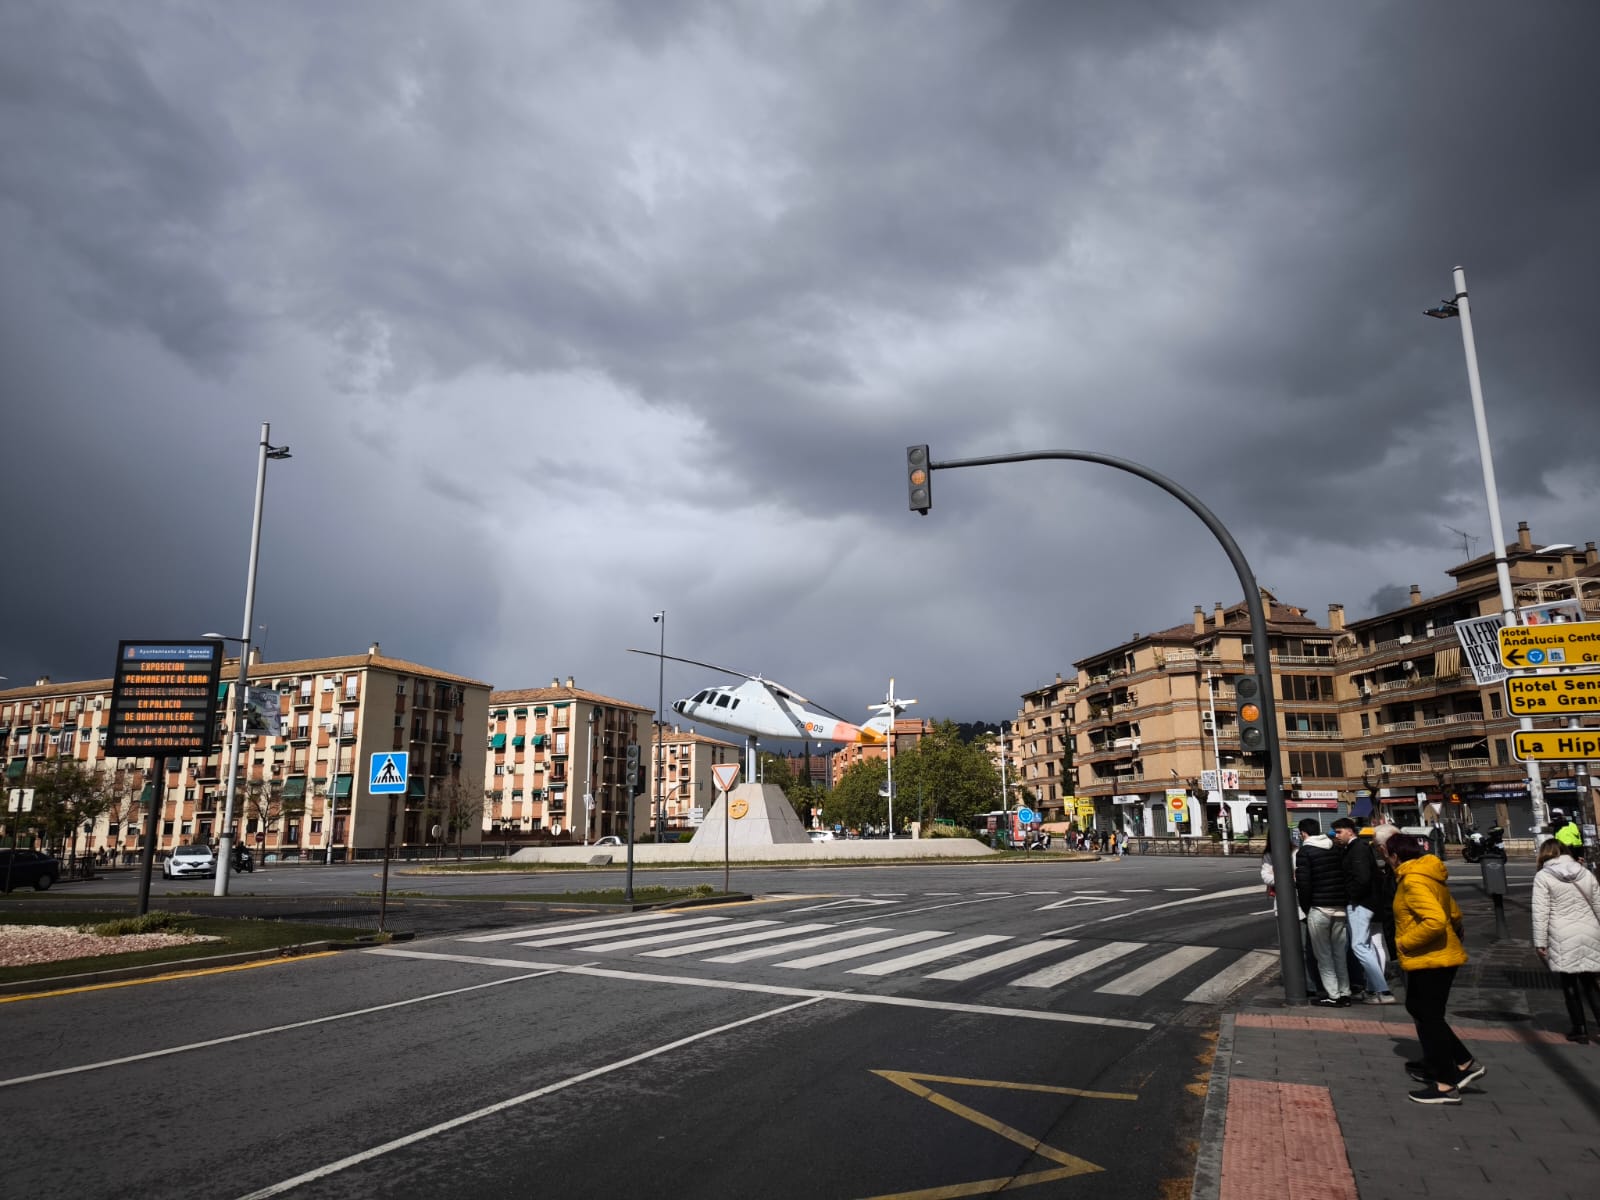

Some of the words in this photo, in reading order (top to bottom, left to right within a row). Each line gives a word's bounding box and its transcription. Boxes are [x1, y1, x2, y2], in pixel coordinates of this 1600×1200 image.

[1459, 624, 1476, 646] LA
[1501, 629, 1530, 638] Hotel
[1503, 634, 1565, 647] Andalucía
[1468, 644, 1491, 667] DEL
[1582, 653, 1600, 662] Gr
[140, 662, 185, 671] EXPOSICION
[125, 674, 175, 684] PERMANENTE
[177, 674, 186, 684] DE
[188, 674, 208, 684] OBRA
[1512, 680, 1557, 692] Hotel
[1564, 679, 1600, 691] Sen
[124, 687, 133, 696] DE
[135, 687, 165, 696] GABRIEL
[168, 687, 207, 696] MORCILLO
[137, 699, 148, 709] EN
[149, 699, 182, 709] PALACIO
[1515, 697, 1546, 709] Spa
[1557, 694, 1600, 705] Gran
[124, 711, 134, 721] DE
[136, 711, 164, 721] QUINTA
[165, 711, 195, 721] ALEGRE
[124, 725, 137, 734] Lun
[145, 725, 157, 734] Vie
[157, 725, 167, 734] de
[813, 724, 824, 733] 09
[143, 738, 152, 746] de
[1519, 739, 1544, 753] La
